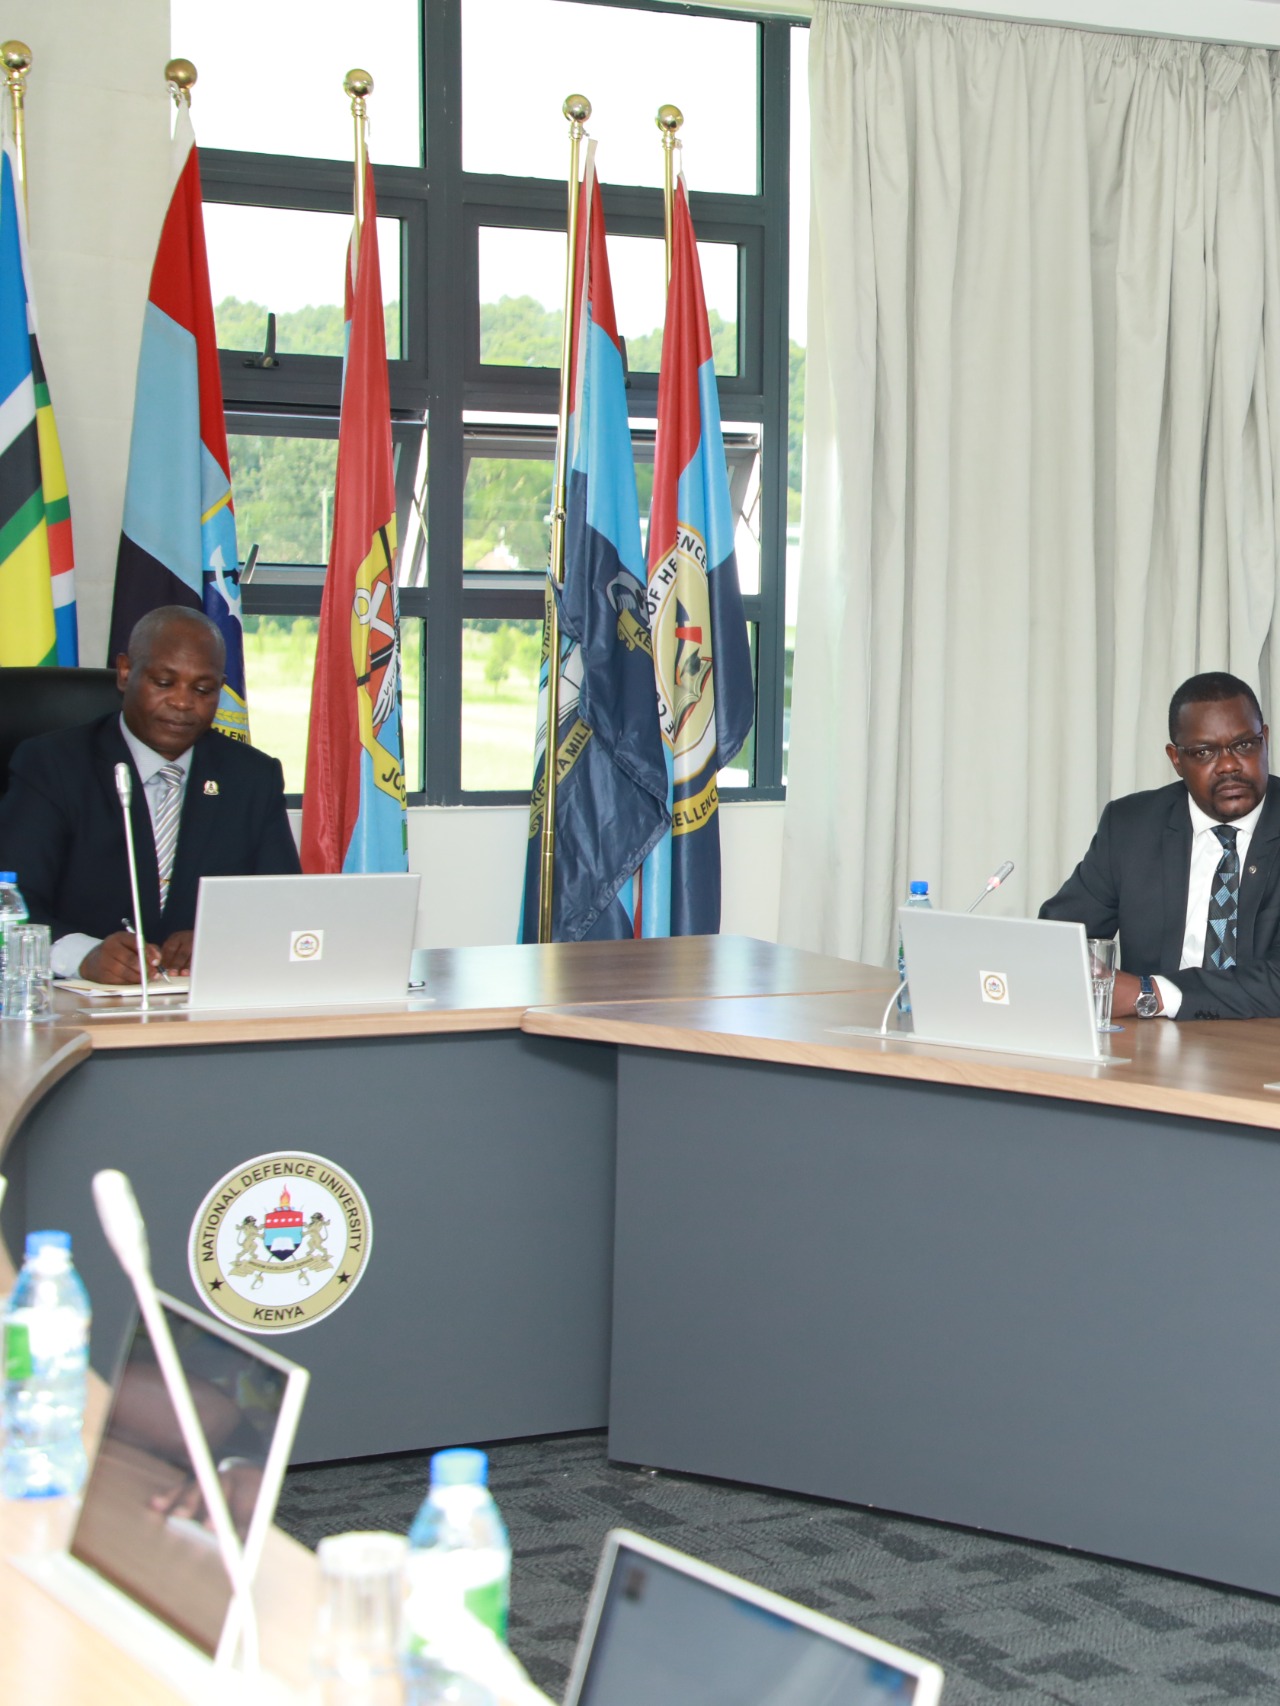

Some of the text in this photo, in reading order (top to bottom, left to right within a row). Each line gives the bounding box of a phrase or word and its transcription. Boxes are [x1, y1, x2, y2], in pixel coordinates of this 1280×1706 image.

[646, 588, 661, 615] OF
[531, 723, 590, 806] KEA MILI
[672, 786, 718, 828] ELLENC
[202, 1163, 362, 1261] NATIONAL DEFENCE UNIVERSITY
[253, 1306, 305, 1321] KENYA
